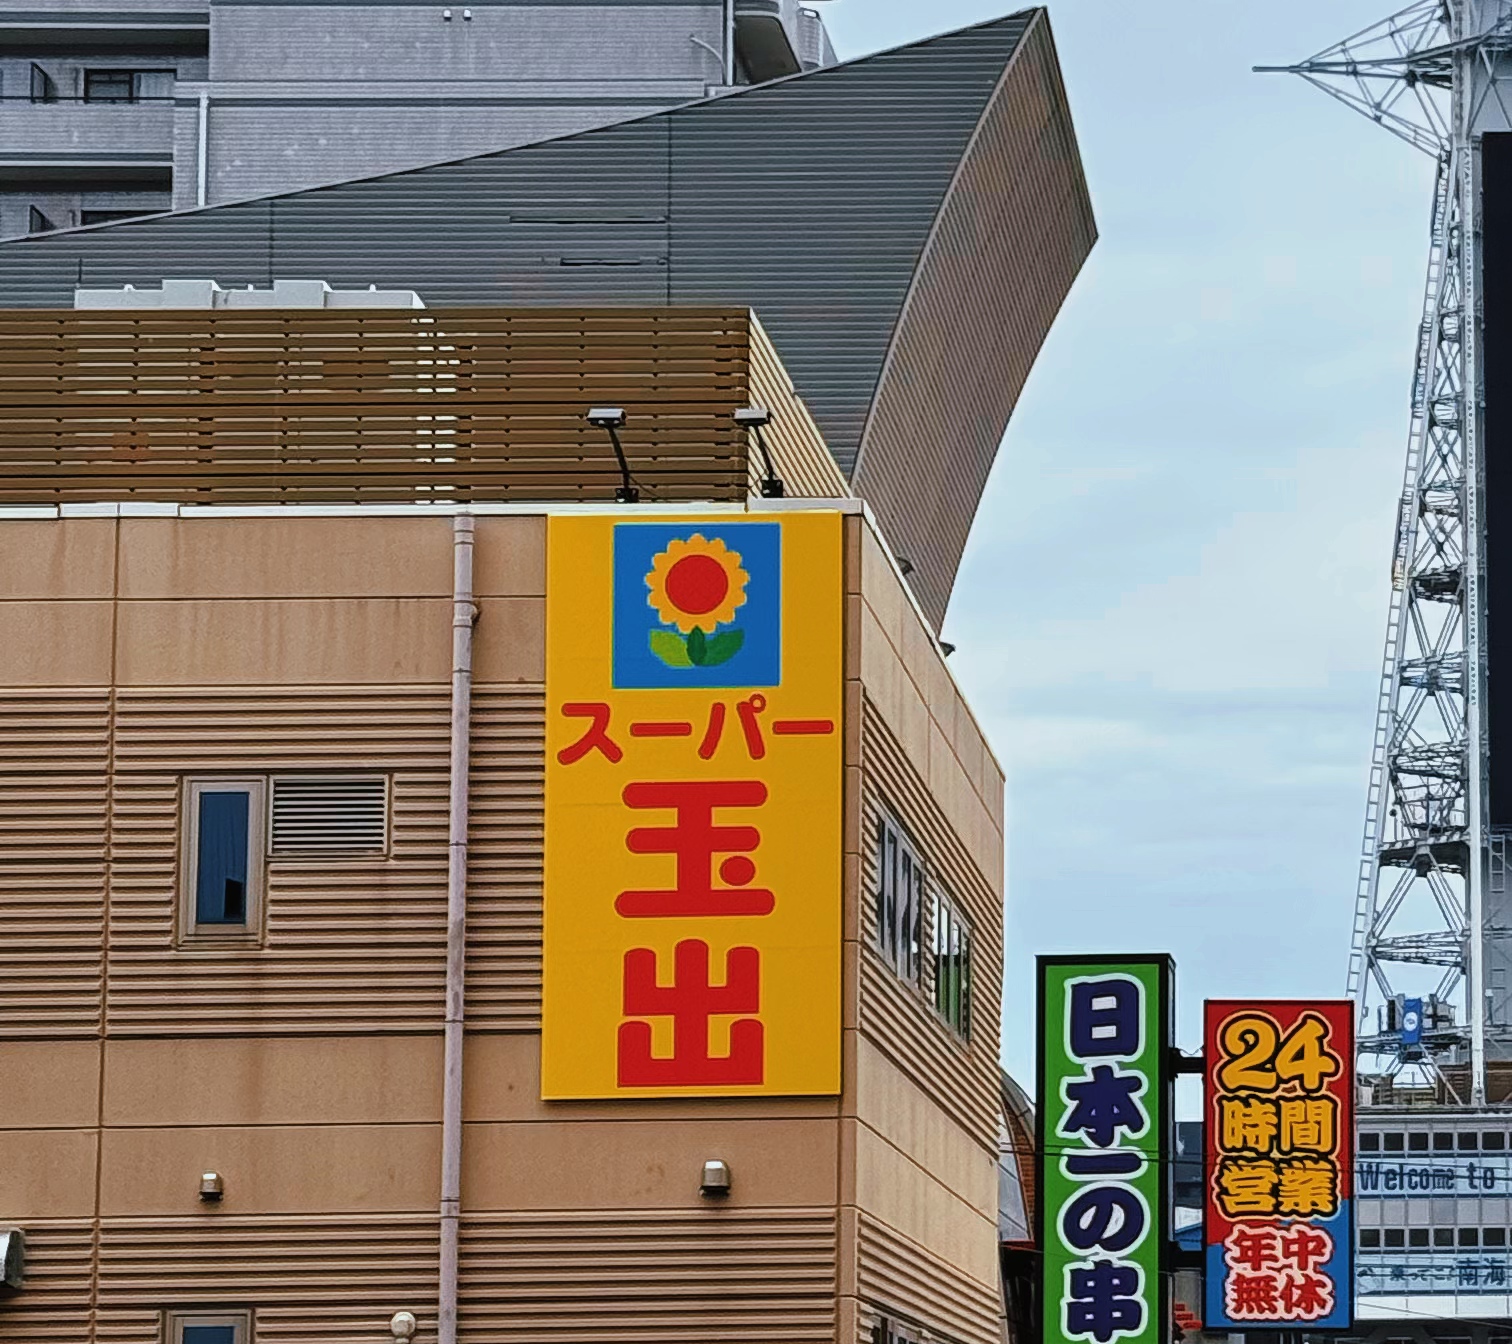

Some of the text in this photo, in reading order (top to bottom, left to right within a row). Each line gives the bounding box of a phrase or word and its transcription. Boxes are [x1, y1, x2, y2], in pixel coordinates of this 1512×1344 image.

[557, 694, 834, 765] スーパー
[614, 780, 775, 1088] 玉出
[1219, 1017, 1336, 1093] 24
[1222, 1100, 1335, 1155] 時間
[1219, 1158, 1335, 1216] 営業
[1359, 1162, 1455, 1191] Welcome
[1467, 1161, 1496, 1188] to
[1231, 1228, 1329, 1274] 年中
[1229, 1270, 1329, 1317] 無休
